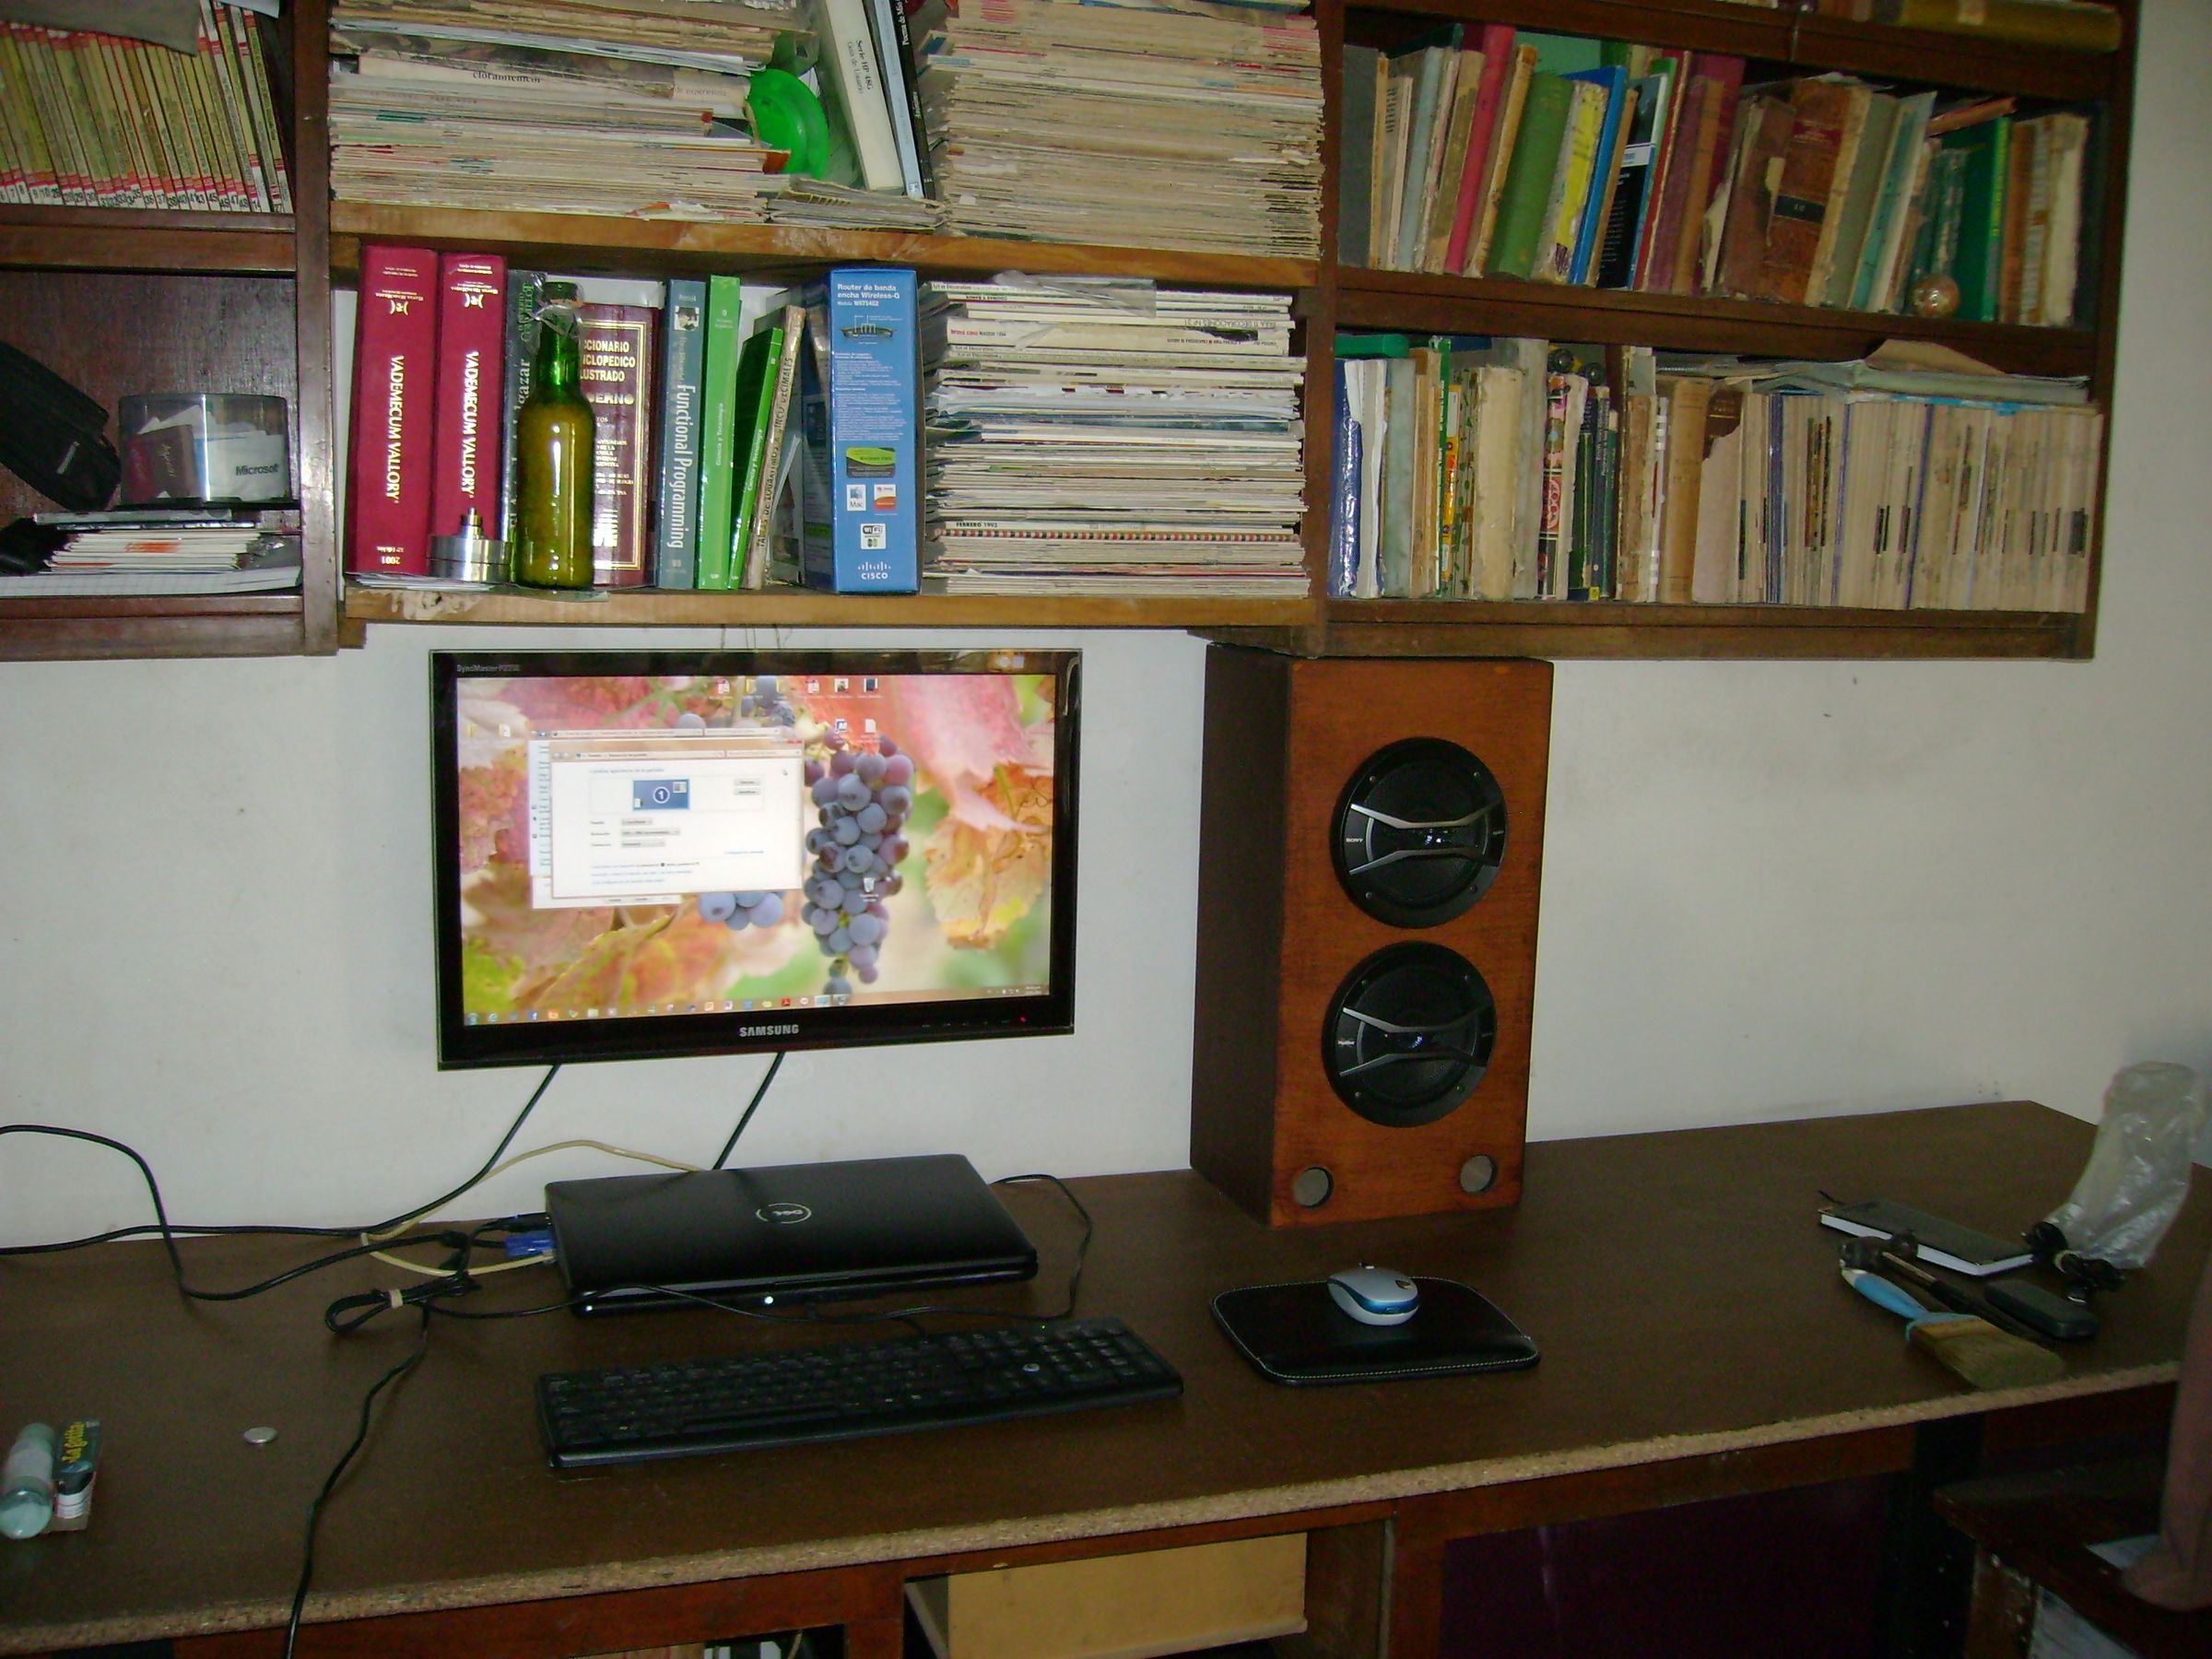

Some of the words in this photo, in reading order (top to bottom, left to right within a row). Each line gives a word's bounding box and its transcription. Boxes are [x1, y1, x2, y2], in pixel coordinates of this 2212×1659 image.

[900, 24, 910, 45] Poema
[856, 40, 865, 60] Serie
[837, 283, 862, 291] Router
[861, 291, 900, 300] Wireless-G
[583, 339, 629, 353] CIONARIO
[582, 354, 636, 368] ICLOPEDICO
[387, 355, 405, 440] VADEMECUM
[463, 350, 480, 434] VADEMECUM
[674, 384, 696, 454] Functional
[235, 463, 279, 476] Microsoft
[385, 441, 403, 501] VALLORY
[461, 437, 477, 496] VALLORY
[667, 458, 693, 549] Programming
[739, 1023, 799, 1038] SAMSUNG
